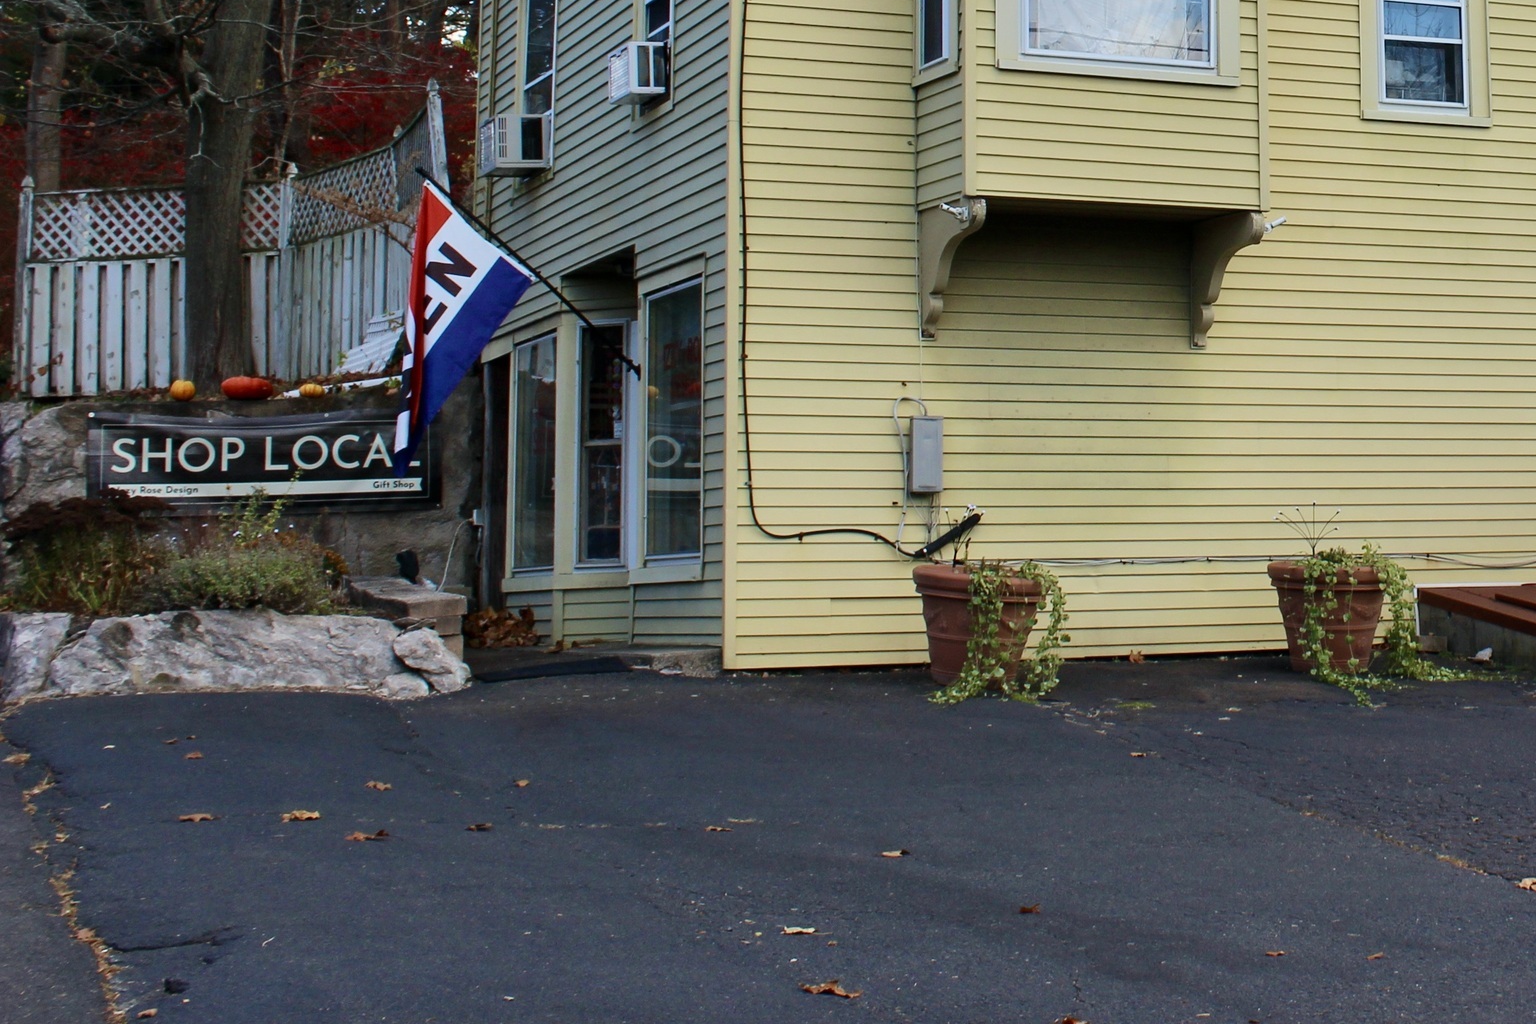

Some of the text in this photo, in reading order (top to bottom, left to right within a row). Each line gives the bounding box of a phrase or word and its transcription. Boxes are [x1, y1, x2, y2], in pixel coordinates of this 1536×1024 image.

[111, 433, 420, 473] SHOP LOCA
[373, 480, 415, 489] Gift Shop
[140, 486, 162, 494] Rose
[166, 486, 199, 495] Design
